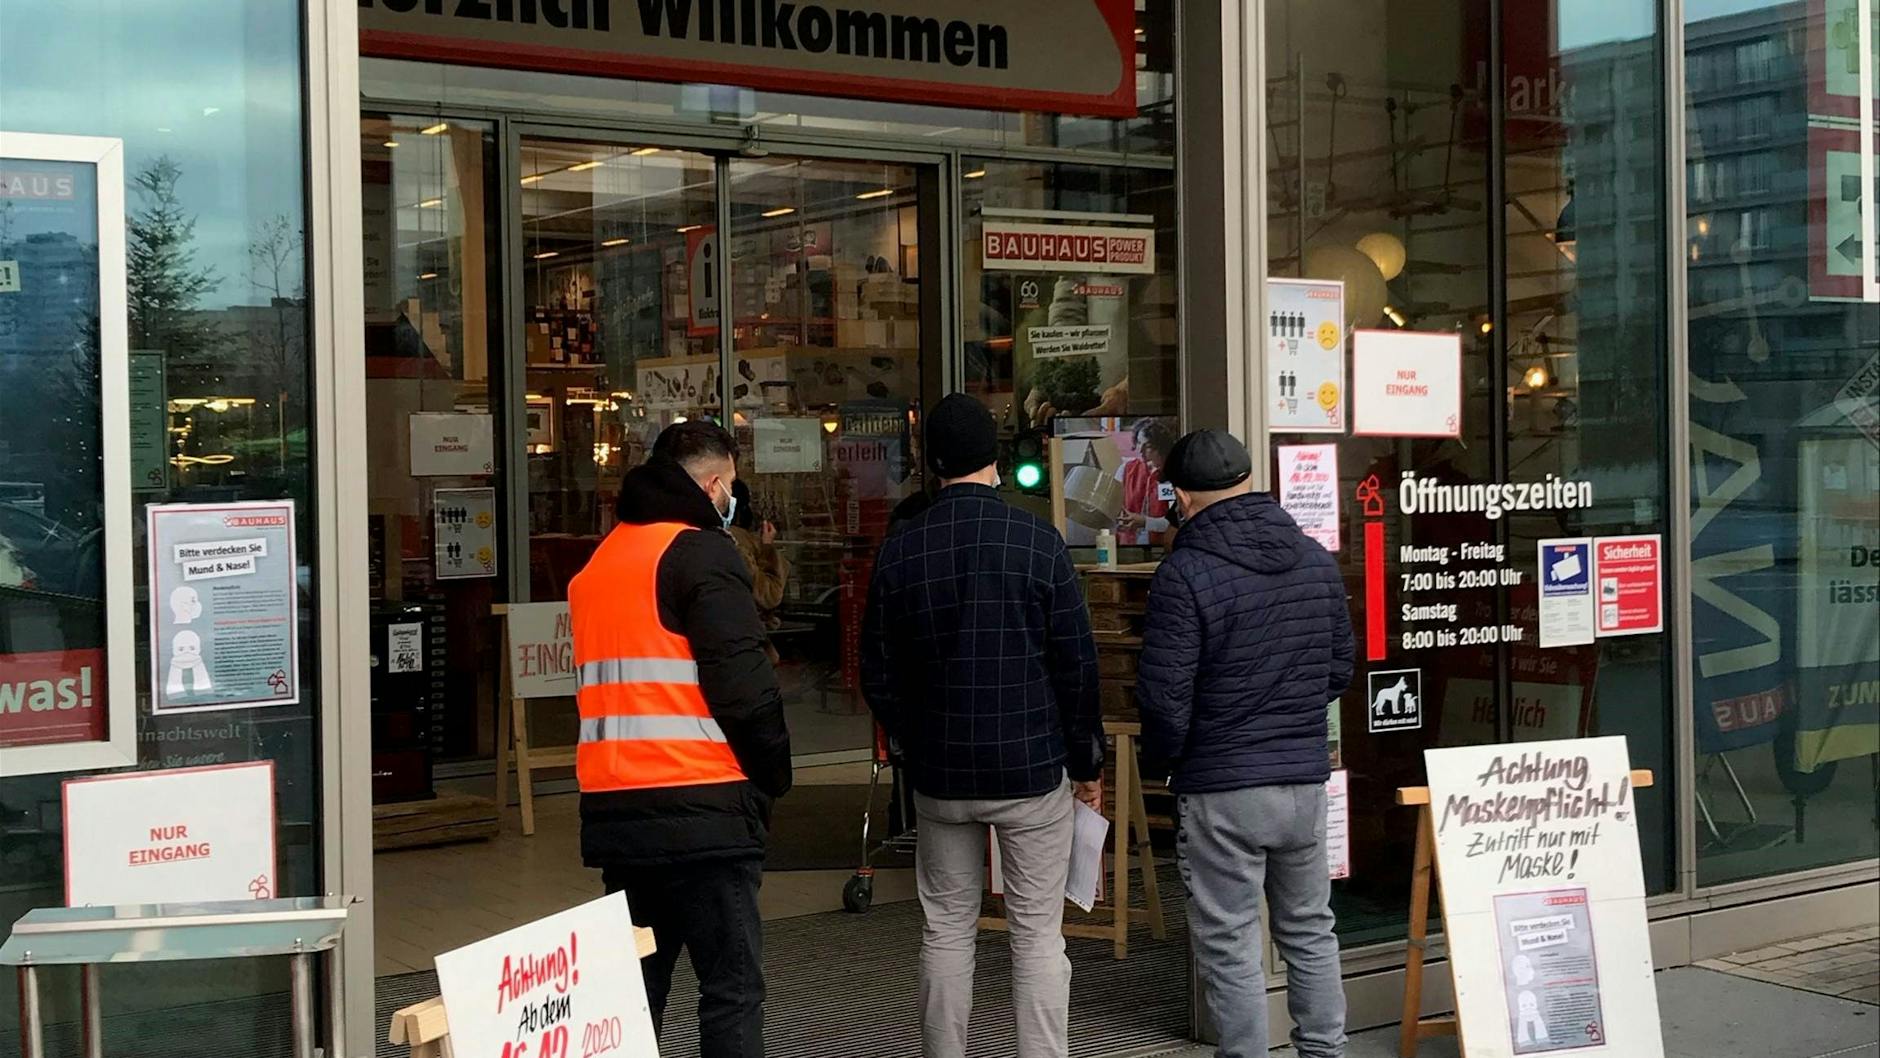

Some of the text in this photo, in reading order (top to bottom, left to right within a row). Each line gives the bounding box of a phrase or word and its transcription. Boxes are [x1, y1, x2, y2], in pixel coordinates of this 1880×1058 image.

[987, 235, 1106, 259] BAUHAUS
[1109, 238, 1144, 252] POWER
[1109, 252, 1144, 263] PRODUKT
[1020, 280, 1039, 298] 60
[1396, 370, 1417, 381] NUR
[1385, 383, 1429, 397] EINGANG
[1399, 471, 1593, 520] Öffnungszeiten
[233, 516, 287, 527] BAUHAUS
[179, 543, 262, 558] Bitte verdecken Sie
[1400, 545, 1449, 565] Montag
[1460, 541, 1505, 562] Freitag
[1603, 543, 1652, 560] Sicherheit
[188, 560, 250, 576] Mund & Nase!
[1401, 568, 1523, 592] 7:00 bis 20:00 Uhr
[1402, 602, 1458, 623] Samstag
[1402, 625, 1524, 650] 8:00 bis 20:00 Uhr
[518, 642, 577, 677] EING
[1477, 751, 1591, 791] Achtung
[1438, 776, 1630, 837] Maskenpflicht!
[149, 825, 188, 842] NUR
[1465, 822, 1601, 858] Zutritt nur mit
[128, 842, 211, 865] EINGANG
[1497, 849, 1579, 884] Maske!
[497, 931, 580, 1015] Achtung!
[516, 1002, 538, 1043] Ab
[538, 993, 571, 1030] dem
[582, 1016, 622, 1058] 2020
